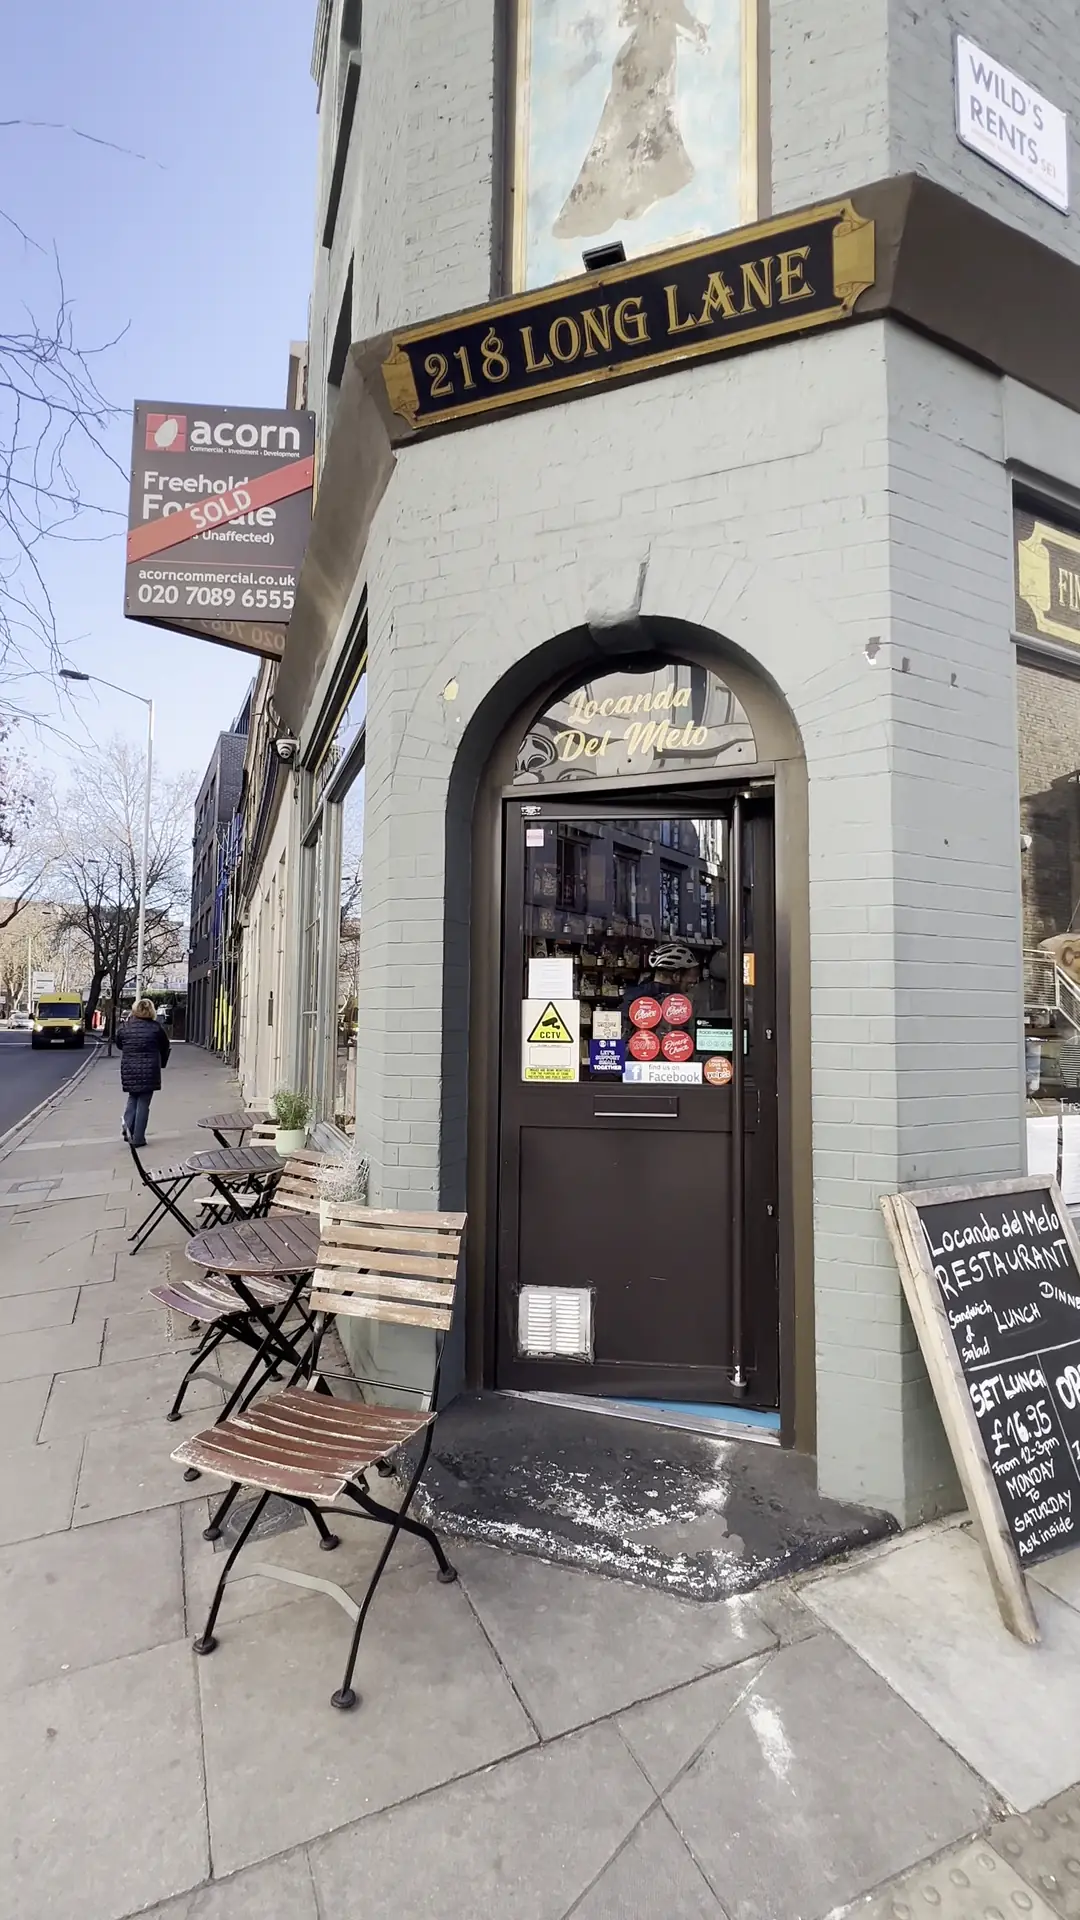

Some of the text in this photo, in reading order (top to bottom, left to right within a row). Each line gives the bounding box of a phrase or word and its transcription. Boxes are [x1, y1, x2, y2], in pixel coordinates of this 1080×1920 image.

[969, 54, 1044, 131] WILD'S
[970, 95, 1039, 165] RENTS
[423, 245, 816, 399] 218 LONG LANE
[190, 420, 300, 450] acorn
[190, 445, 224, 453] Commercial
[263, 450, 300, 458] Development
[143, 494, 196, 519] Fo
[190, 490, 251, 528] SOLD
[202, 530, 275, 545] Unaffected)
[138, 584, 295, 609] 020 7089 6555
[139, 569, 295, 586] acorncommercial.co.uk
[567, 683, 693, 726] Locanda
[553, 719, 709, 762] Del Melo
[540, 1031, 561, 1039] CCTV
[648, 1071, 701, 1082] Facebook
[920, 1204, 1060, 1257] Locanda del Melo
[934, 1238, 1069, 1301] RESTAURANT
[949, 1300, 993, 1330] Sandwich
[993, 1302, 1042, 1334] LUNCH
[969, 1369, 1048, 1418] SET LUNCH
[991, 1400, 1052, 1456] £16.95
[992, 1456, 1020, 1477] From
[1020, 1437, 1060, 1465] 12-3pm
[1005, 1458, 1055, 1500] MONDAY
[1014, 1490, 1072, 1533] SATURDAY
[1040, 1516, 1074, 1544] inside
